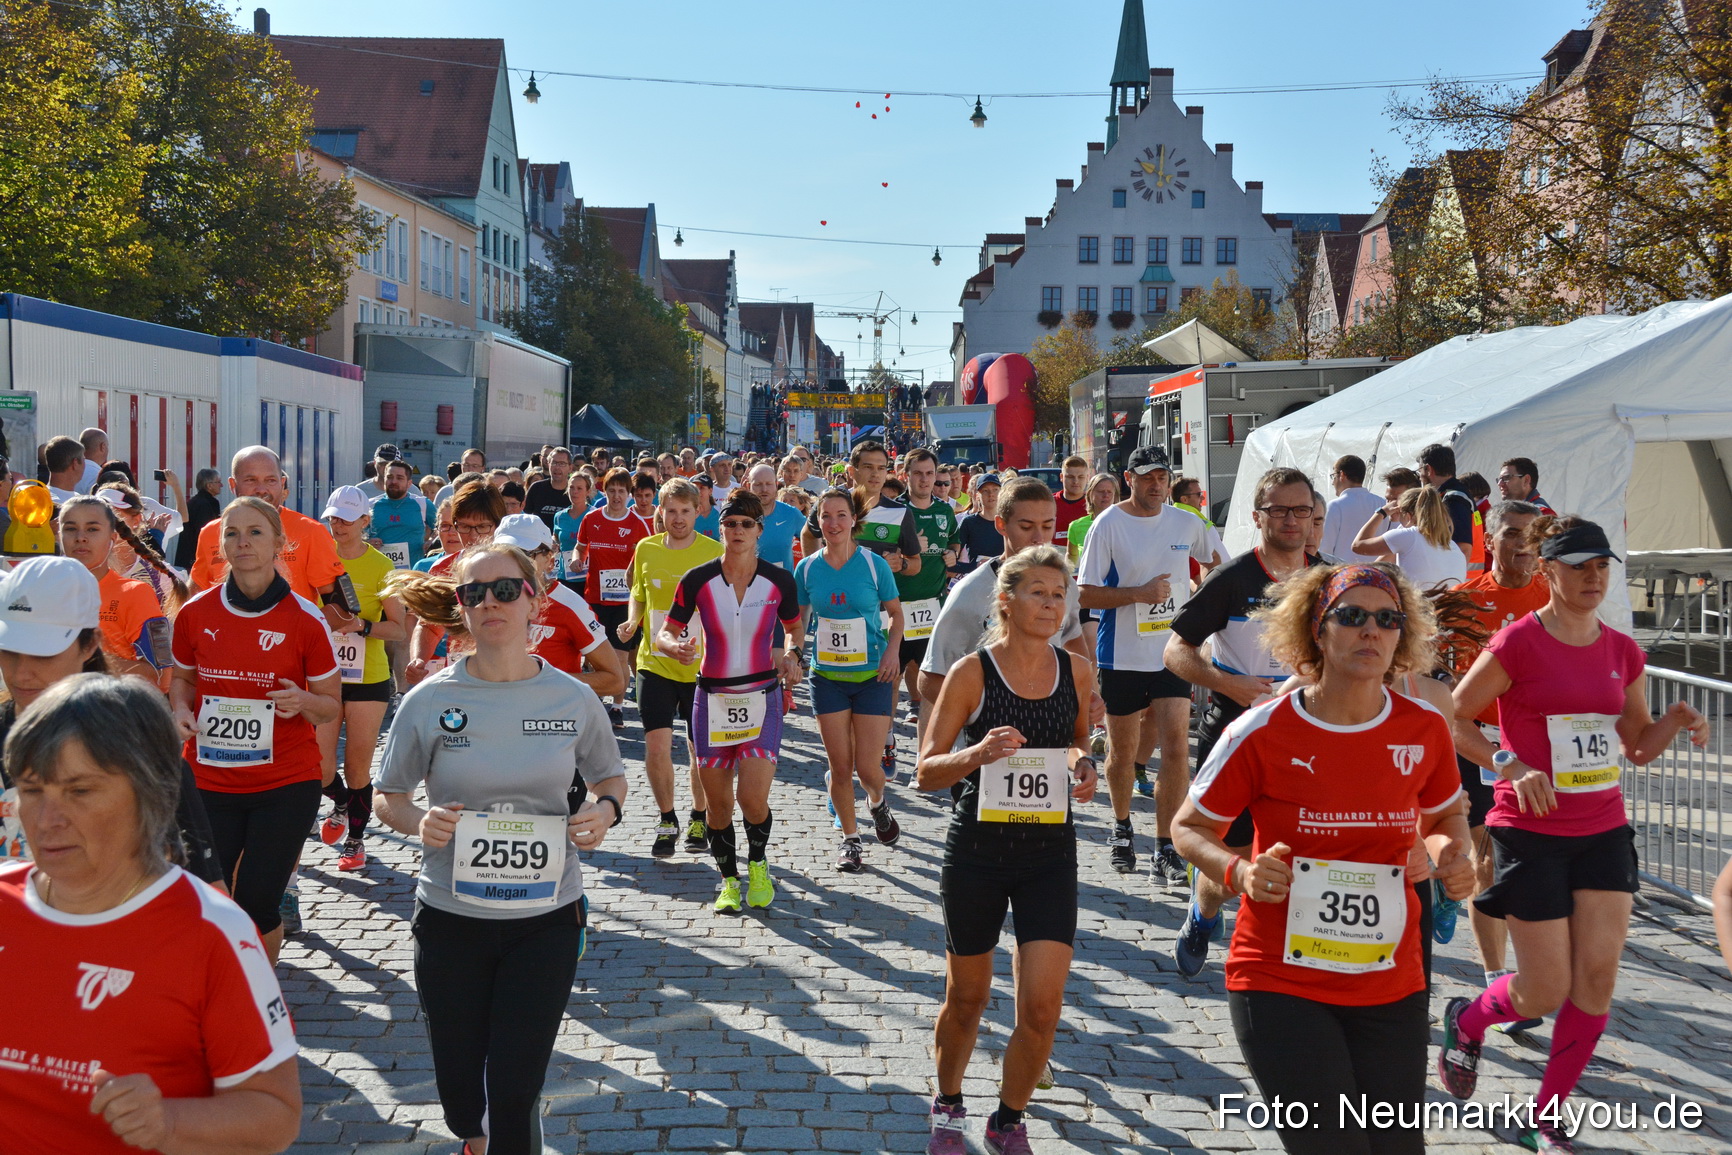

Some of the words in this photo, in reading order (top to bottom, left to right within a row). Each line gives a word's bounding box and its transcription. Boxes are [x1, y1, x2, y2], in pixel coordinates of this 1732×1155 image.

[820, 396, 854, 404] START
[382, 551, 404, 561] 084
[1149, 598, 1176, 615] 234
[910, 609, 933, 623] 172
[832, 633, 847, 647] 81
[219, 704, 251, 713] BOCK
[728, 708, 749, 723] 53
[207, 716, 261, 740] 2209
[522, 719, 577, 732] BOCK
[443, 735, 471, 743] PARTL
[725, 732, 749, 740] Melanie
[1572, 733, 1609, 758] 145
[216, 750, 250, 760] Claudia
[1008, 757, 1045, 766] BOCK
[1004, 772, 1048, 798] 196
[1572, 771, 1612, 785] Alexandra
[1008, 813, 1040, 823] Gisela
[1299, 808, 1372, 820] ENGELHARDT
[1377, 812, 1384, 820] &
[488, 820, 534, 832] BOCK
[1297, 826, 1339, 836] Amberg
[470, 838, 549, 870] 2559
[1328, 870, 1376, 885] BOCK
[485, 886, 528, 900] Megan
[1318, 891, 1380, 927] 359
[1313, 927, 1338, 937] PARTL
[1340, 930, 1374, 939] Neumarkt
[1311, 941, 1350, 958] Marion
[45, 1056, 101, 1075] WALTER
